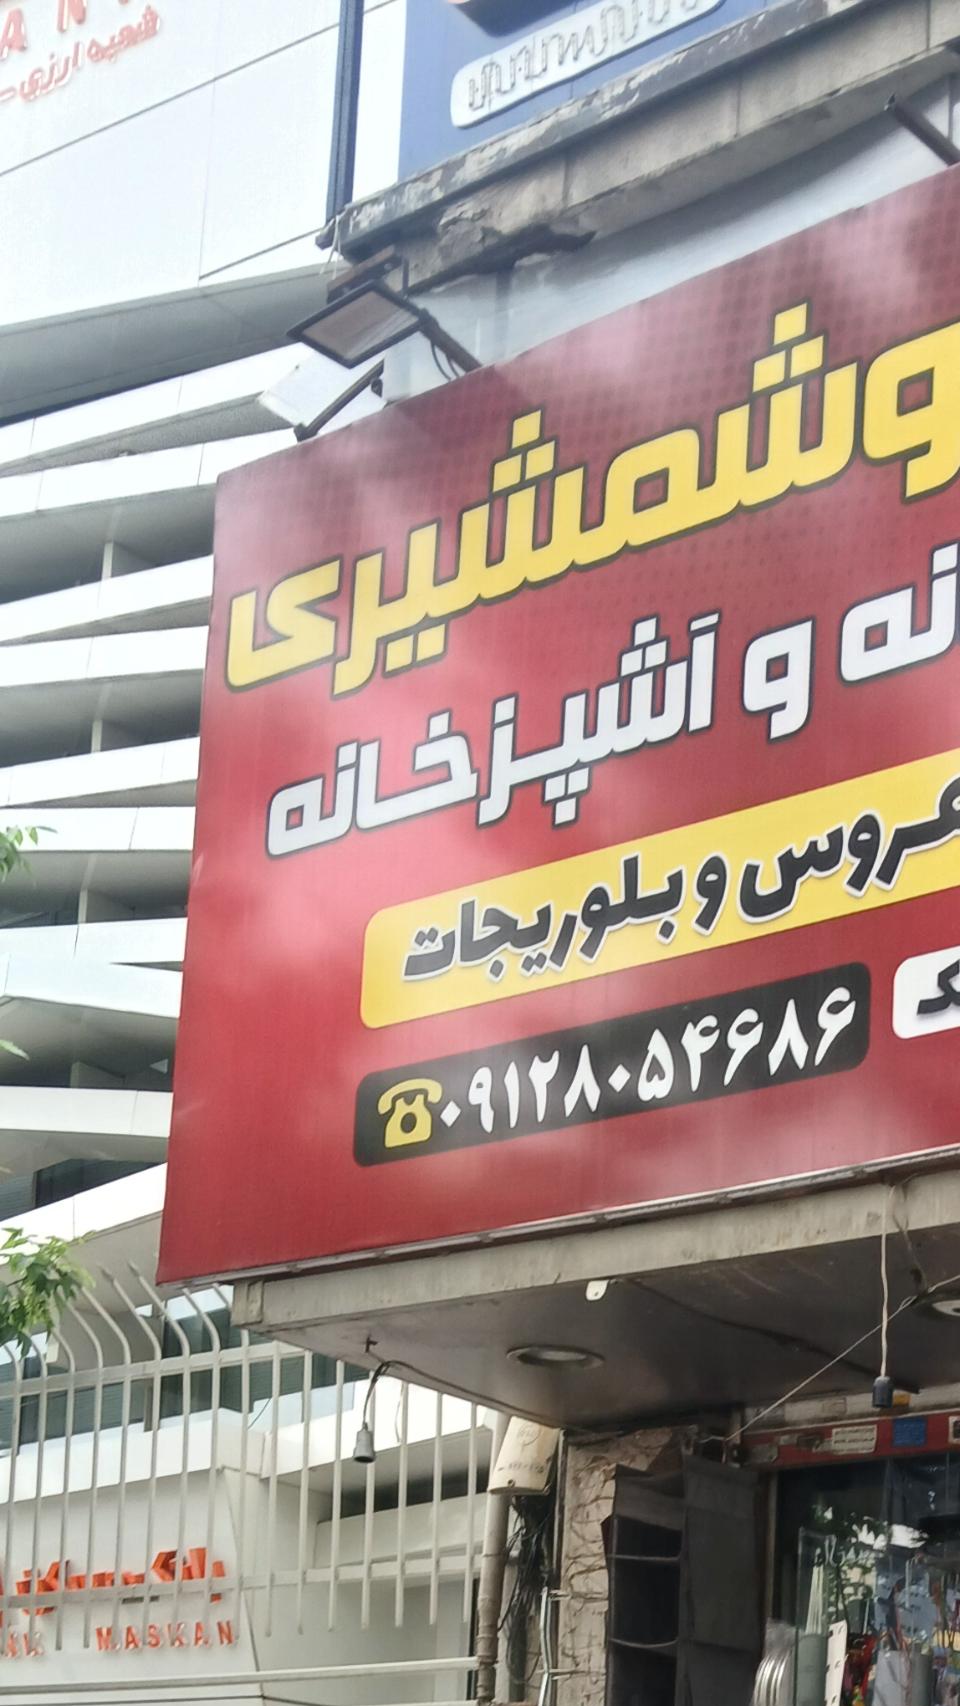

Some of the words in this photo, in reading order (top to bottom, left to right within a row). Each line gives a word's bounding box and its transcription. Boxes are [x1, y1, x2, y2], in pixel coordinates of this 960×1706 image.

[226, 302, 858, 696] شمشیری
[266, 610, 720, 858] آشپزخانه
[742, 618, 814, 741] و
[693, 854, 729, 933] و
[440, 986, 857, 1134] ۰۹۱۲۸۰۵۴۶۸۶
[95, 1619, 234, 1652] MASKAN
